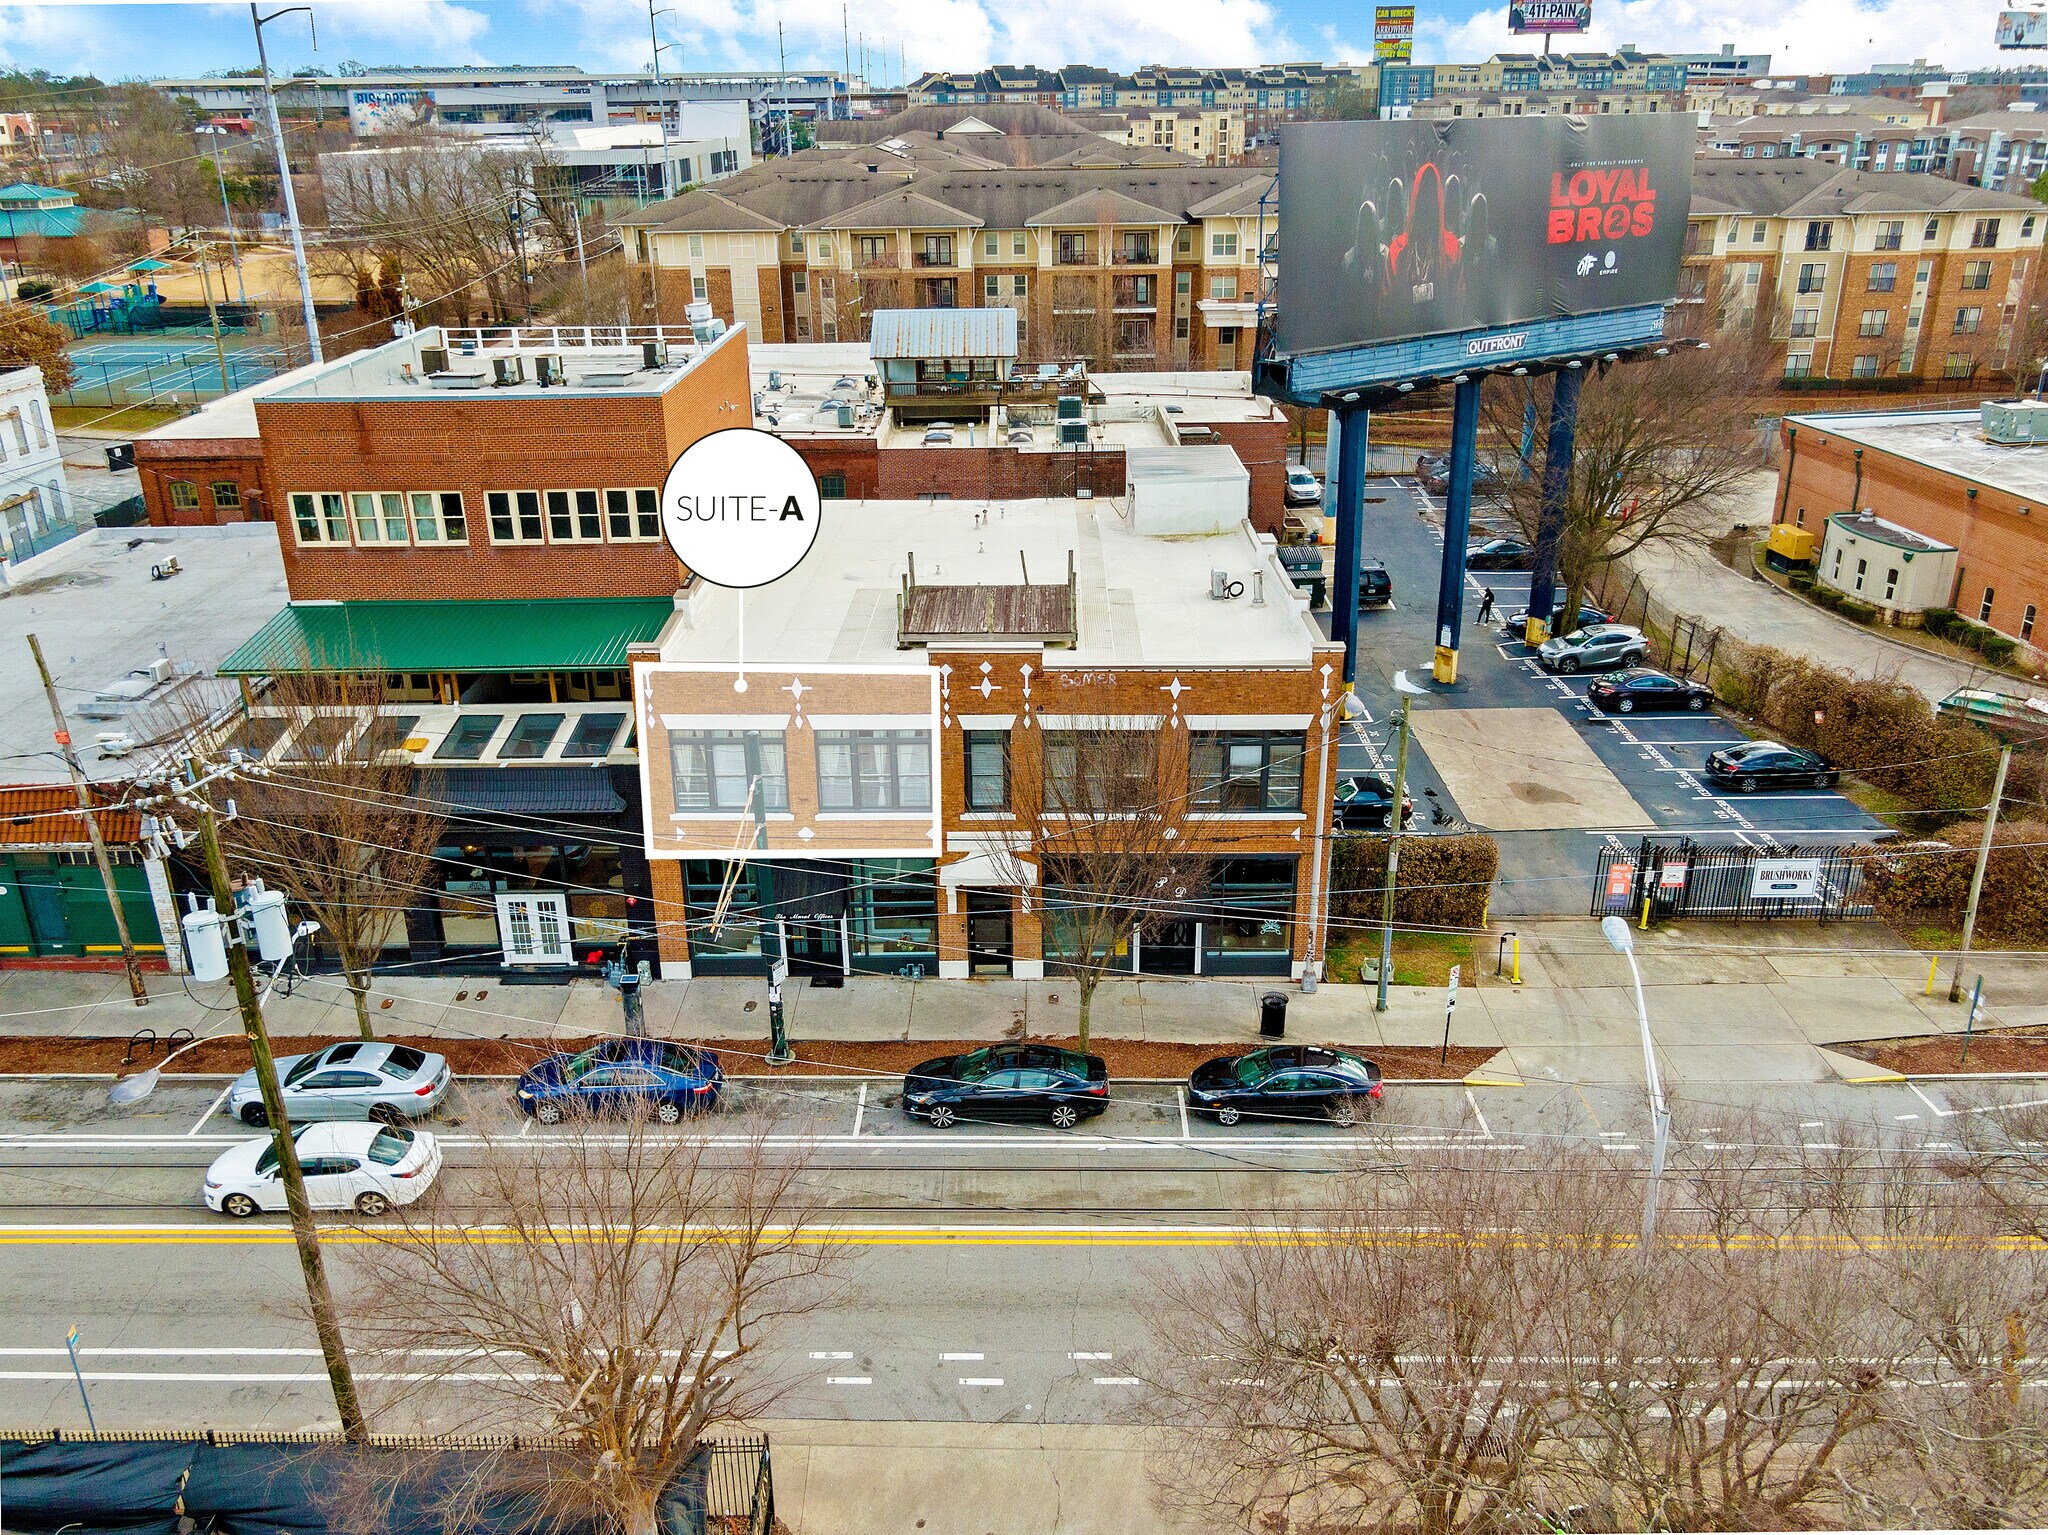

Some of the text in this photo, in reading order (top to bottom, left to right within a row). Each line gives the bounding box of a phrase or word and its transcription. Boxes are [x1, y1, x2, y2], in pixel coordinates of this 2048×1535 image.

[1376, 25, 1413, 34] ARROWHEAD
[1952, 75, 1966, 83] VOTE
[1550, 168, 1657, 207] LOYAL
[1469, 335, 1525, 353] OUTFRONT
[1611, 719, 1638, 741] RESERVED
[1641, 744, 1674, 768] RESERVED
[1675, 781, 1690, 789] 19
[1677, 770, 1712, 796] RESERVED
[1713, 809, 1730, 819] 20
[1714, 799, 1754, 829] RESERVED
[1760, 869, 1813, 880] BRUSHWORKS
